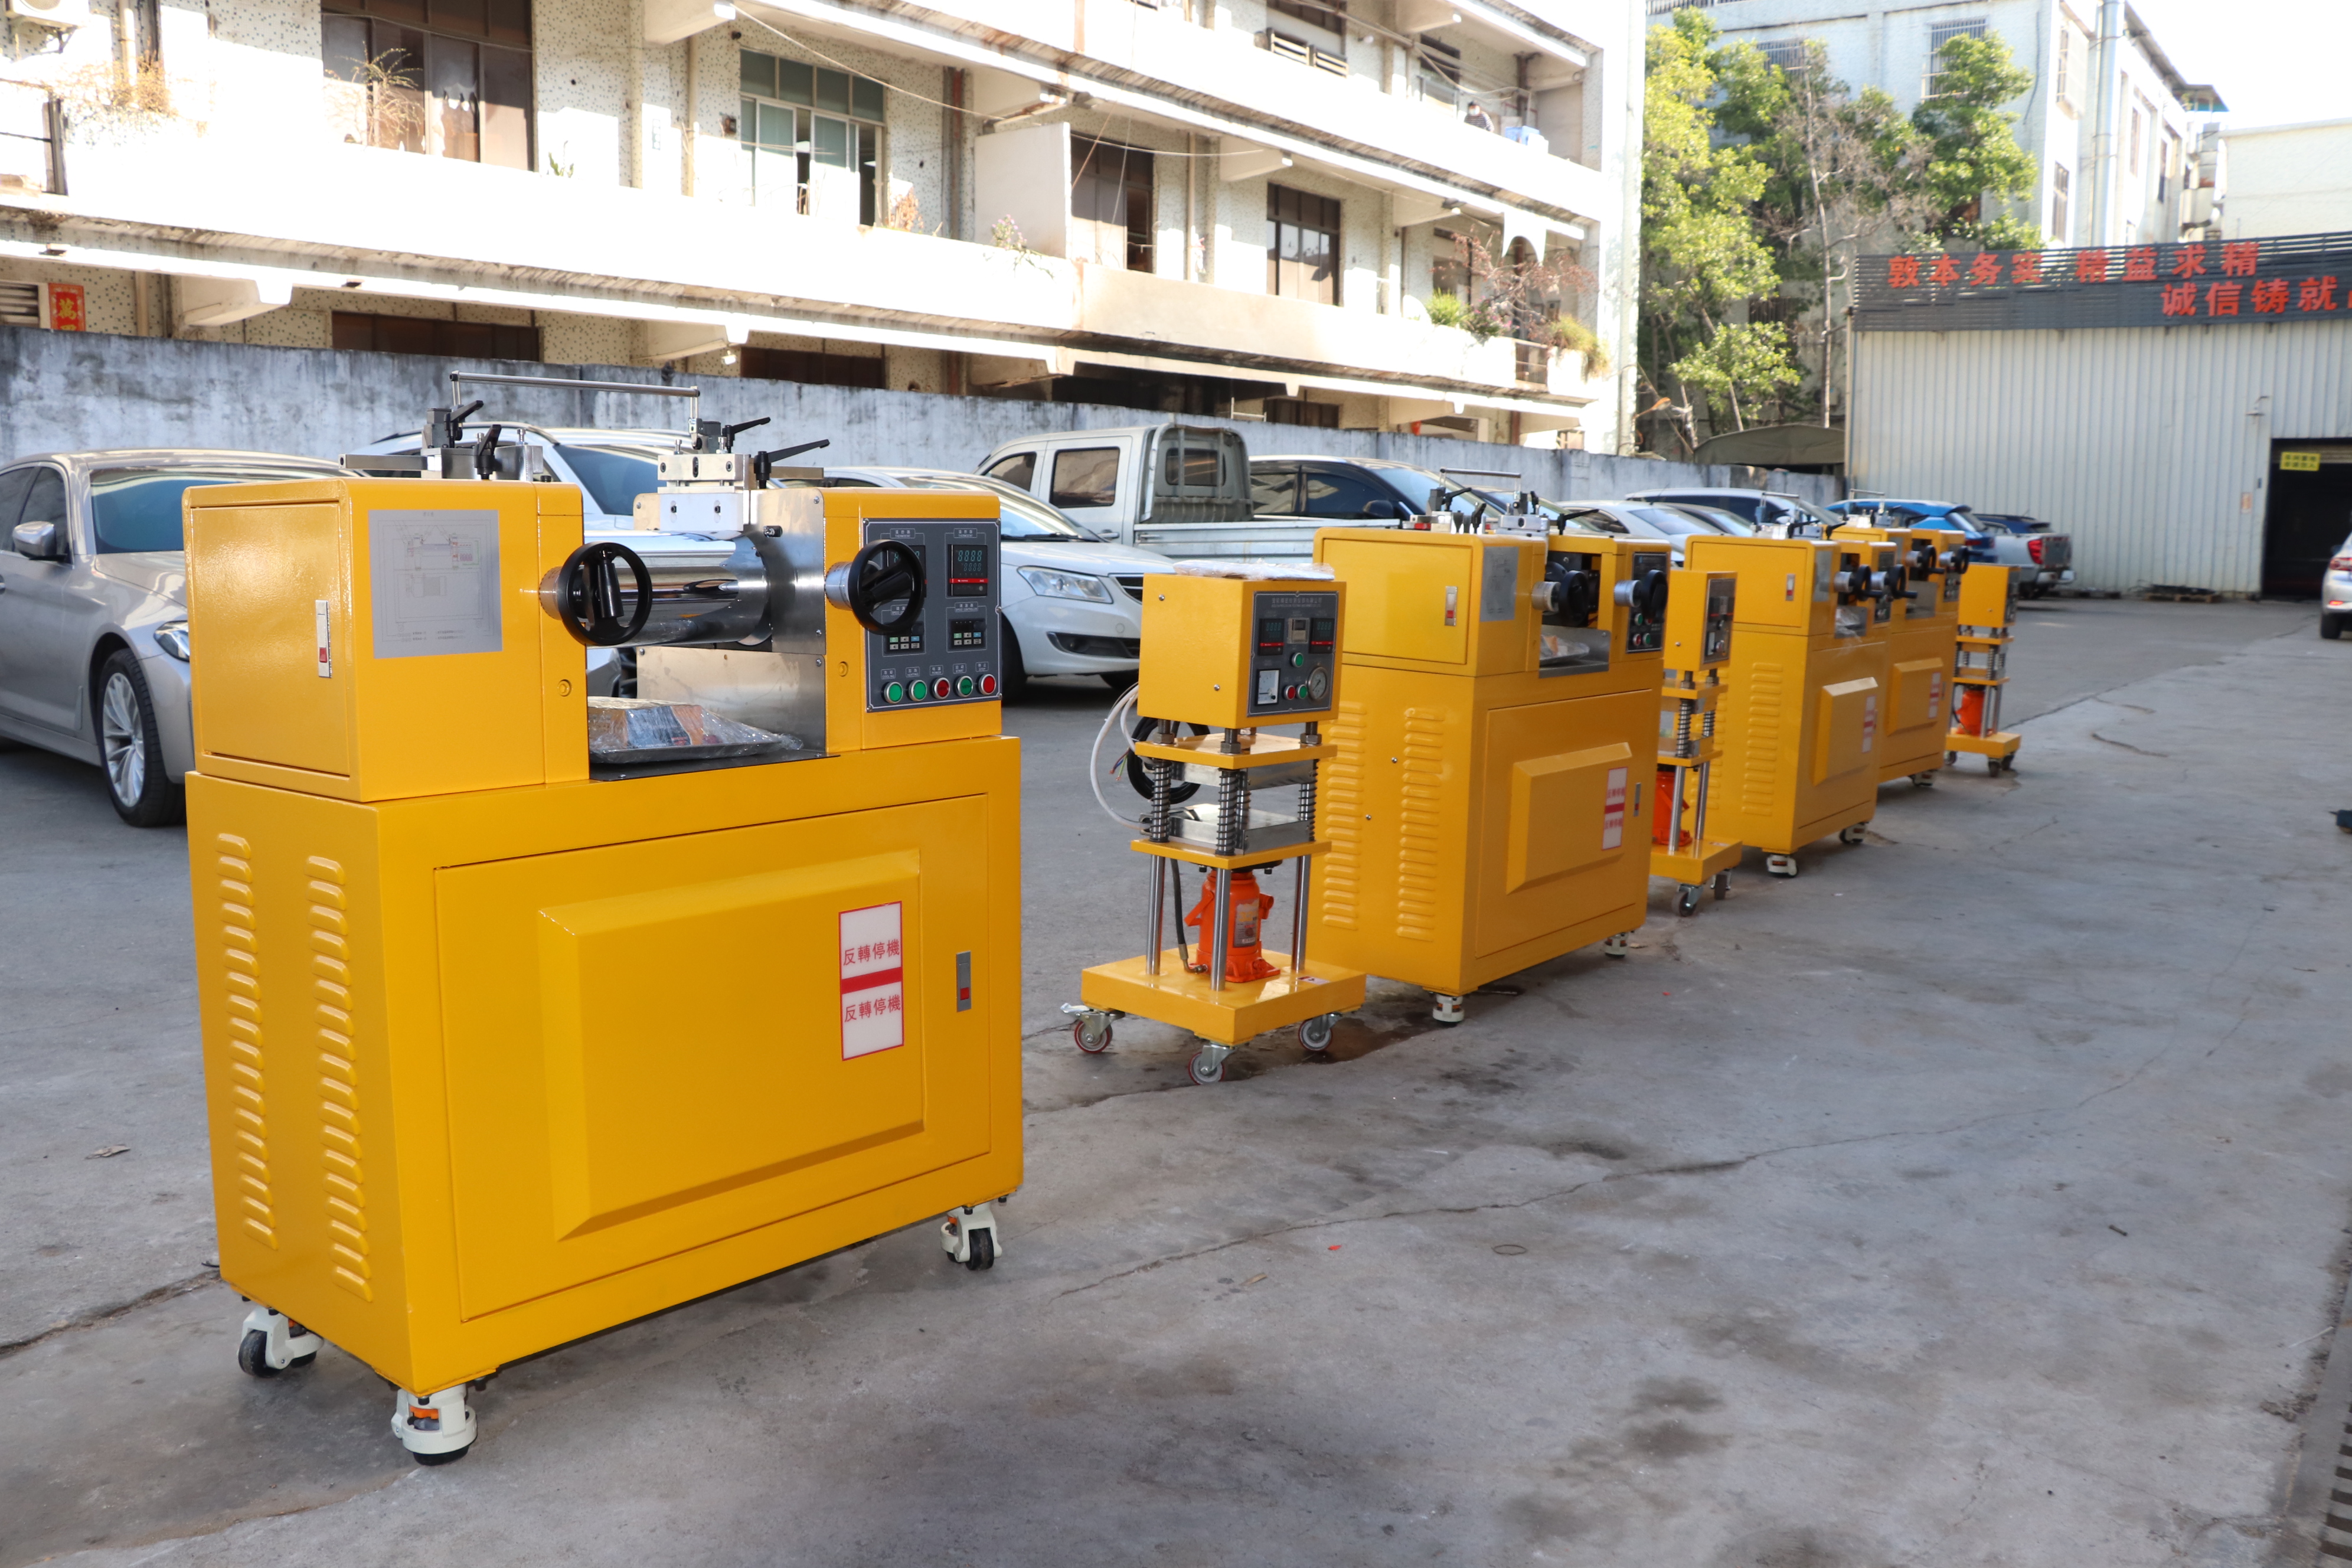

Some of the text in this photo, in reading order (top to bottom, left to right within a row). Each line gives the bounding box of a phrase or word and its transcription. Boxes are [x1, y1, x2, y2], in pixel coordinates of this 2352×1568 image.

[1888, 241, 2260, 288] 敦本务实 精益求精
[2160, 275, 2352, 316] 诚信铸就
[842, 939, 900, 966] 反轉停機
[844, 994, 901, 1023] 反轉停機
